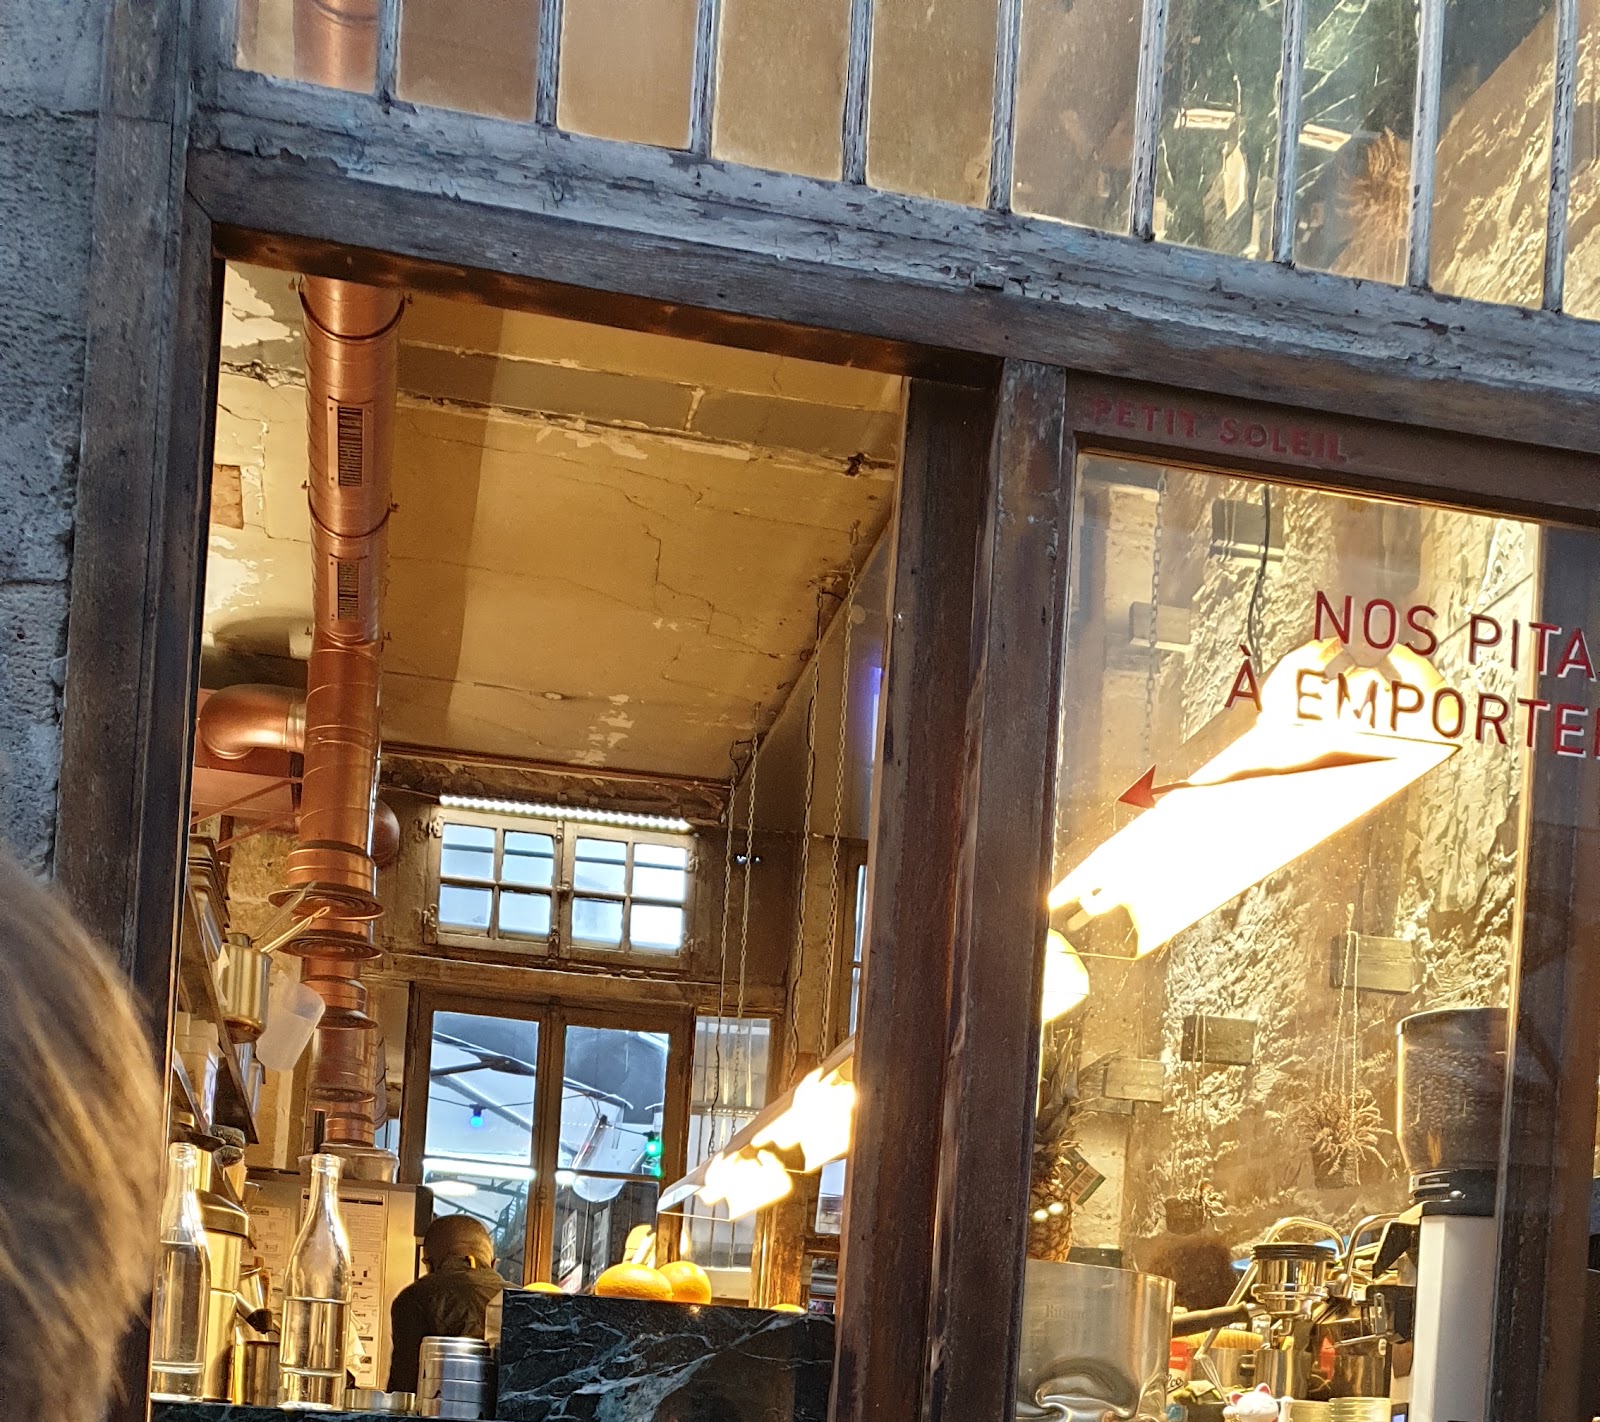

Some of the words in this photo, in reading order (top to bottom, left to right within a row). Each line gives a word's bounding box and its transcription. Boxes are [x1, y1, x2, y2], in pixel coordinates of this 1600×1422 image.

[1091, 396, 1197, 438] PETIT
[1219, 418, 1347, 464] SOLEIL
[1314, 591, 1438, 656] NOS
[1225, 644, 1262, 713] À
